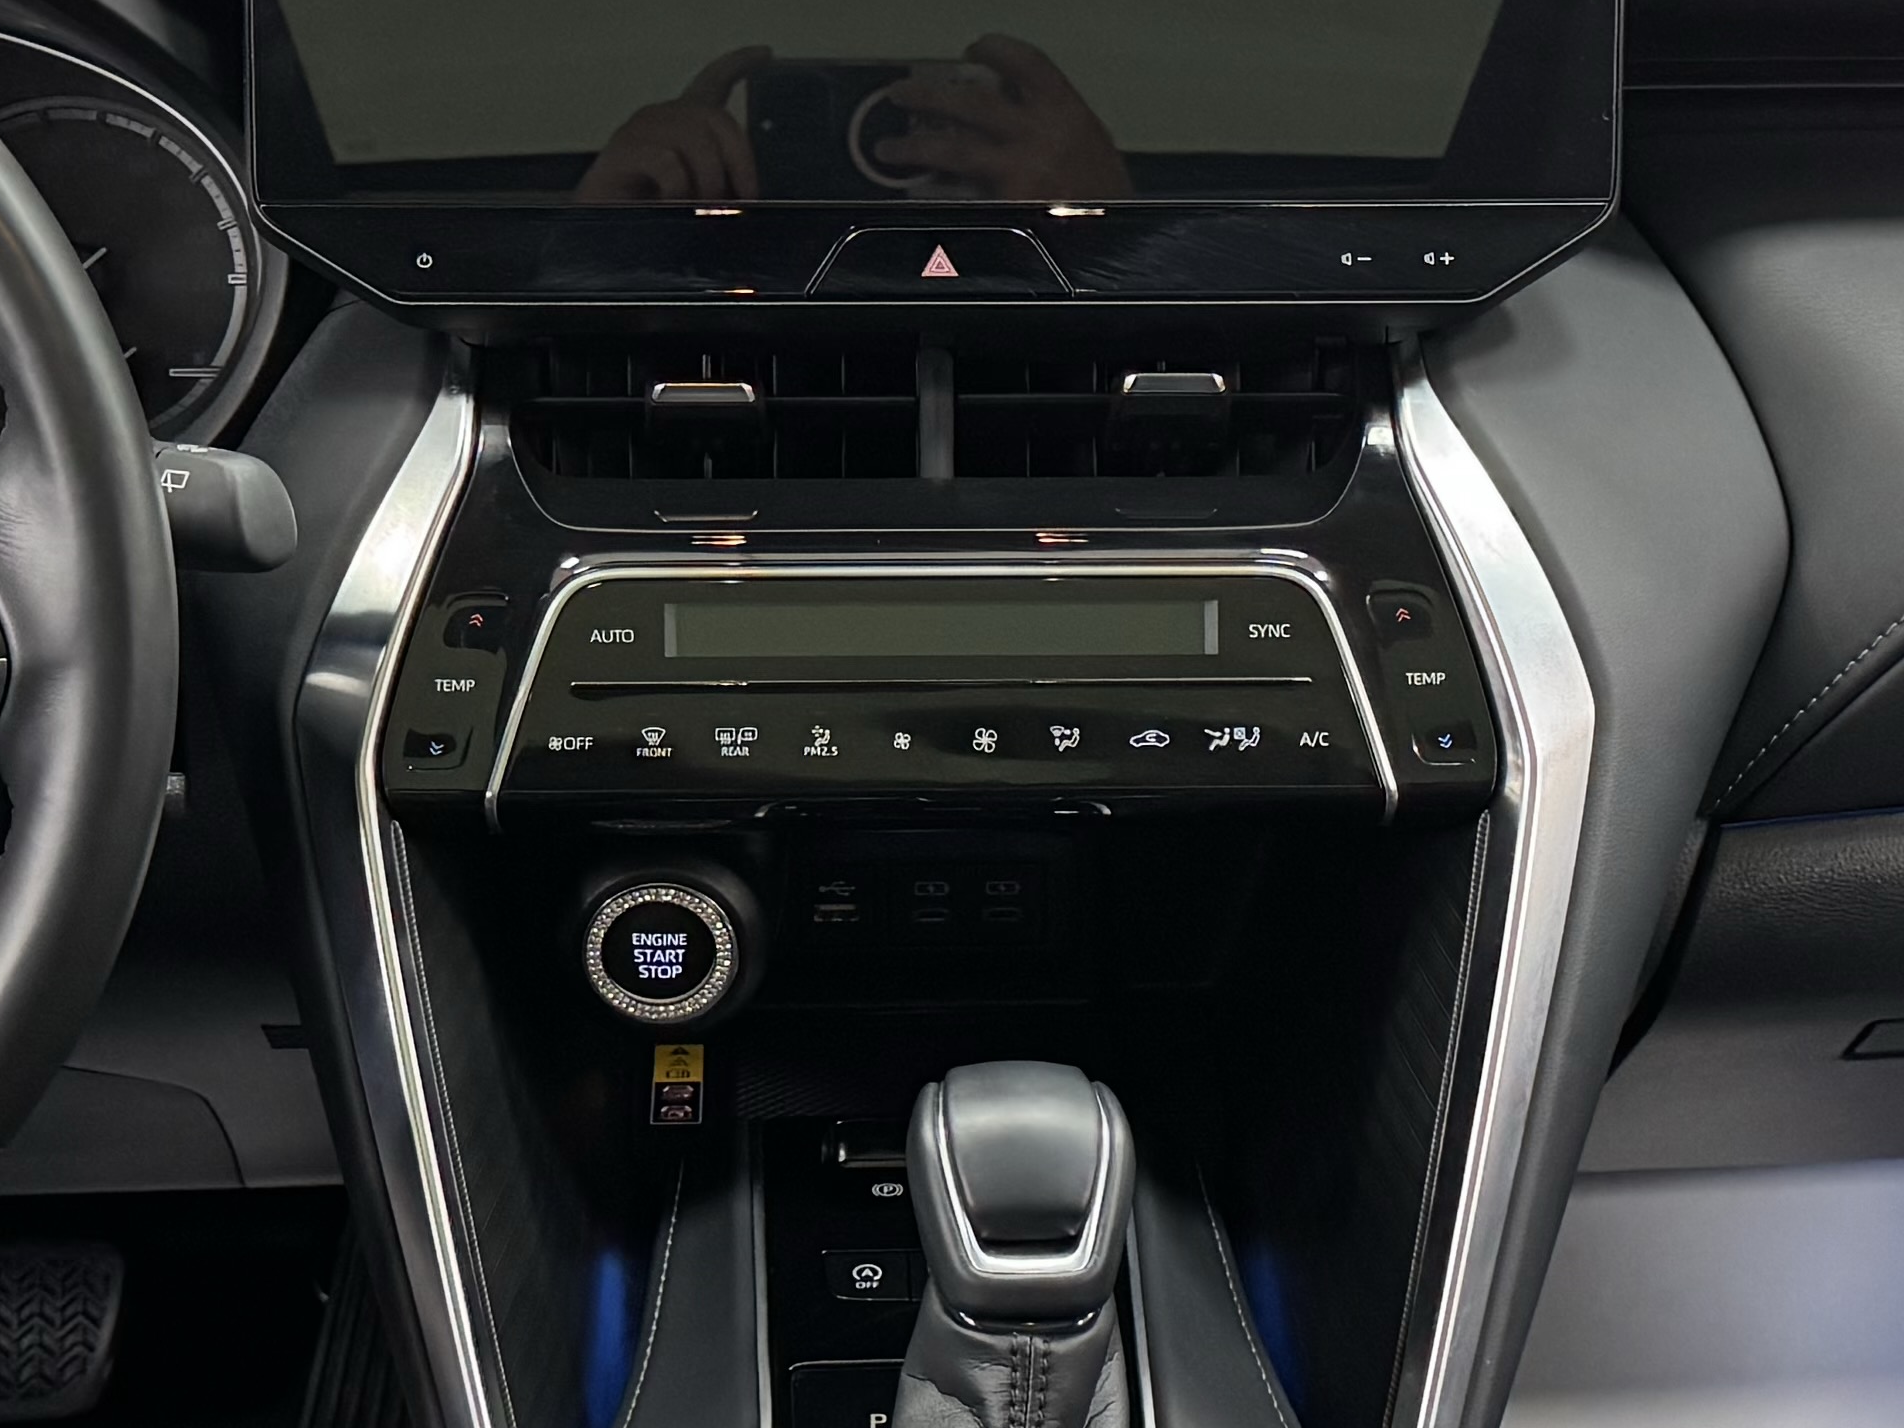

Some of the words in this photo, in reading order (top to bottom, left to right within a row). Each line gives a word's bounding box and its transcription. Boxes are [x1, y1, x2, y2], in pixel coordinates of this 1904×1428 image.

[589, 628, 635, 644] AUTO
[1248, 623, 1291, 638] SYNC
[434, 678, 476, 692] TEMP
[1405, 672, 1446, 686] TEMP
[563, 736, 594, 751] OFF
[1299, 731, 1330, 747] A/C
[636, 747, 673, 758] FRONT
[720, 746, 750, 757] REAR
[803, 745, 839, 757] PM2.5
[631, 932, 688, 947] ENGINE
[633, 948, 686, 963] START
[638, 964, 683, 979] STOP
[855, 1281, 880, 1289] OFF
